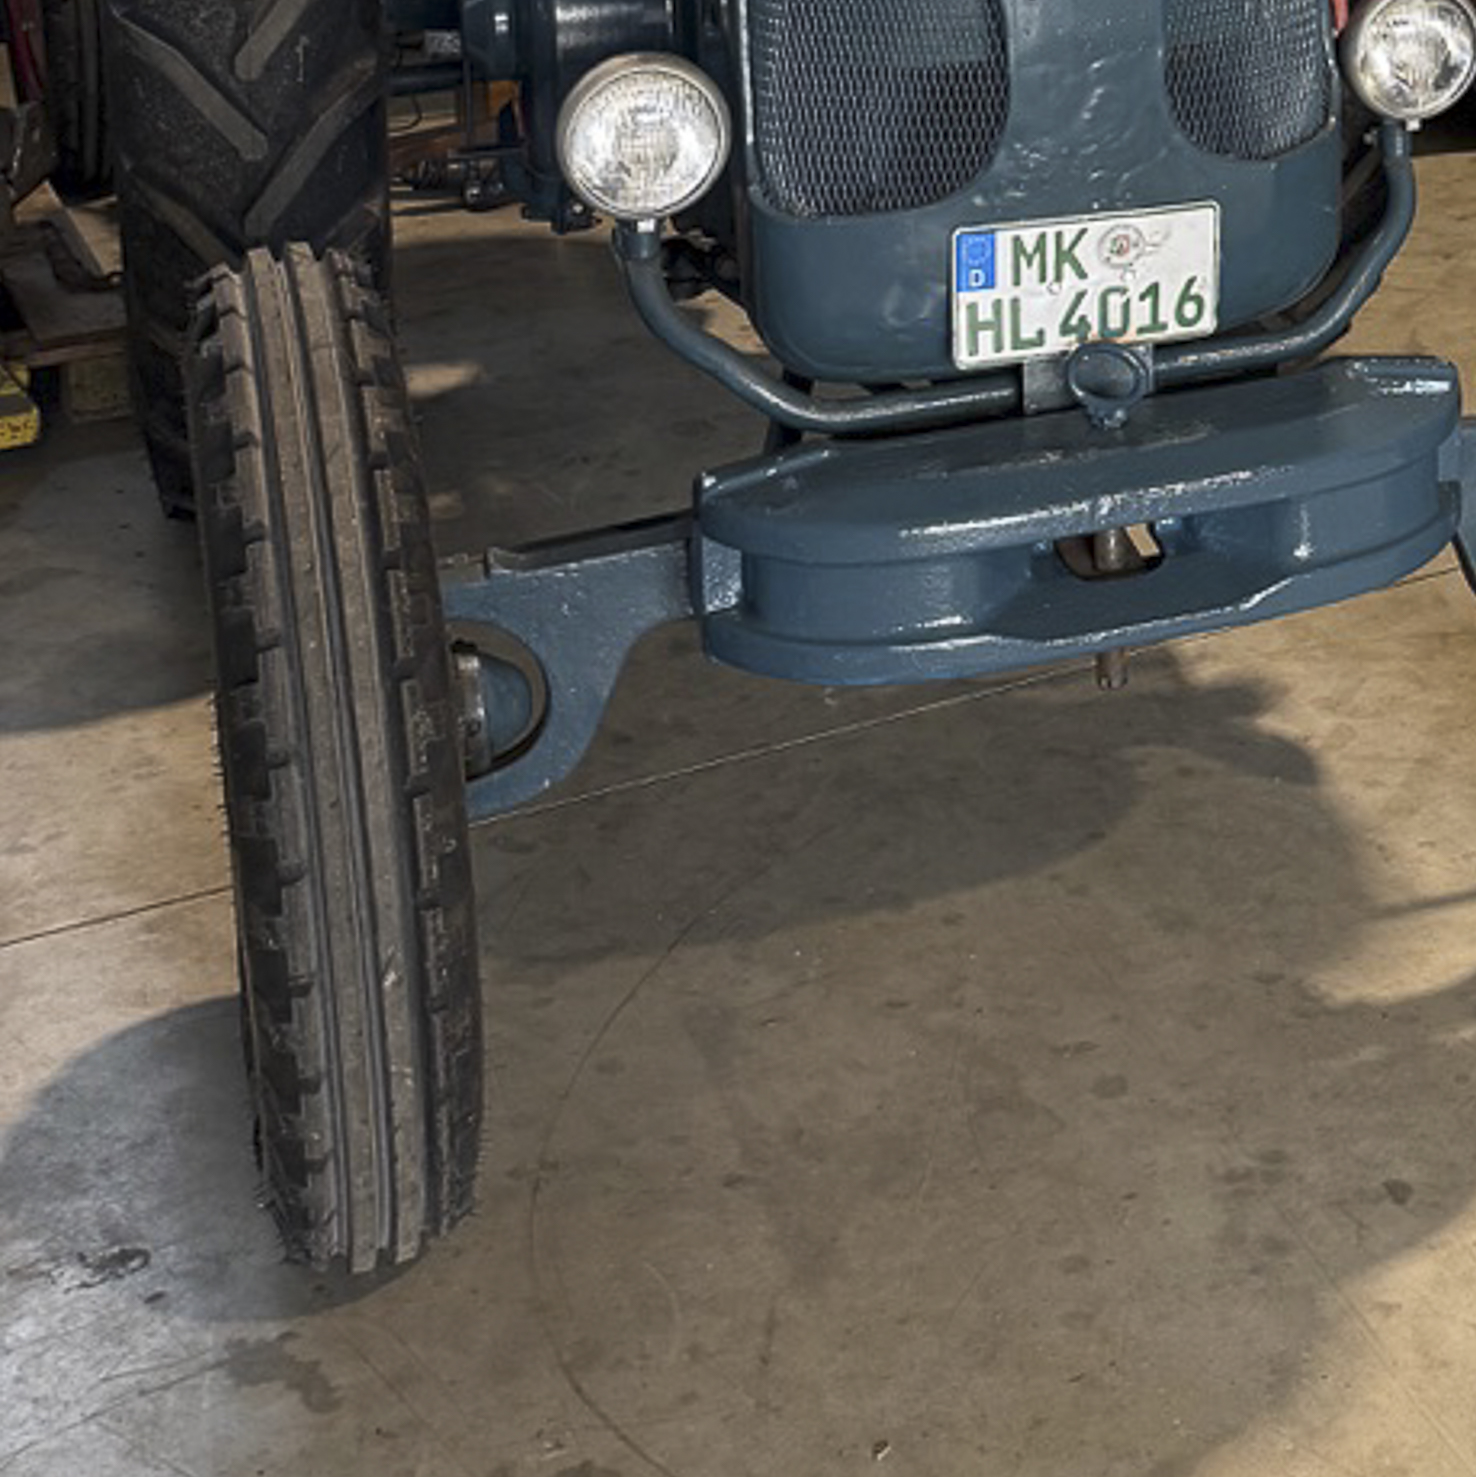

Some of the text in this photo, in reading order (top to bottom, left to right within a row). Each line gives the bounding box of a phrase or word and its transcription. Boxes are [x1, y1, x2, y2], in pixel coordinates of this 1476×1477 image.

[969, 269, 986, 288] D
[1011, 227, 1089, 288] MK
[965, 275, 1206, 357] HL 4016
